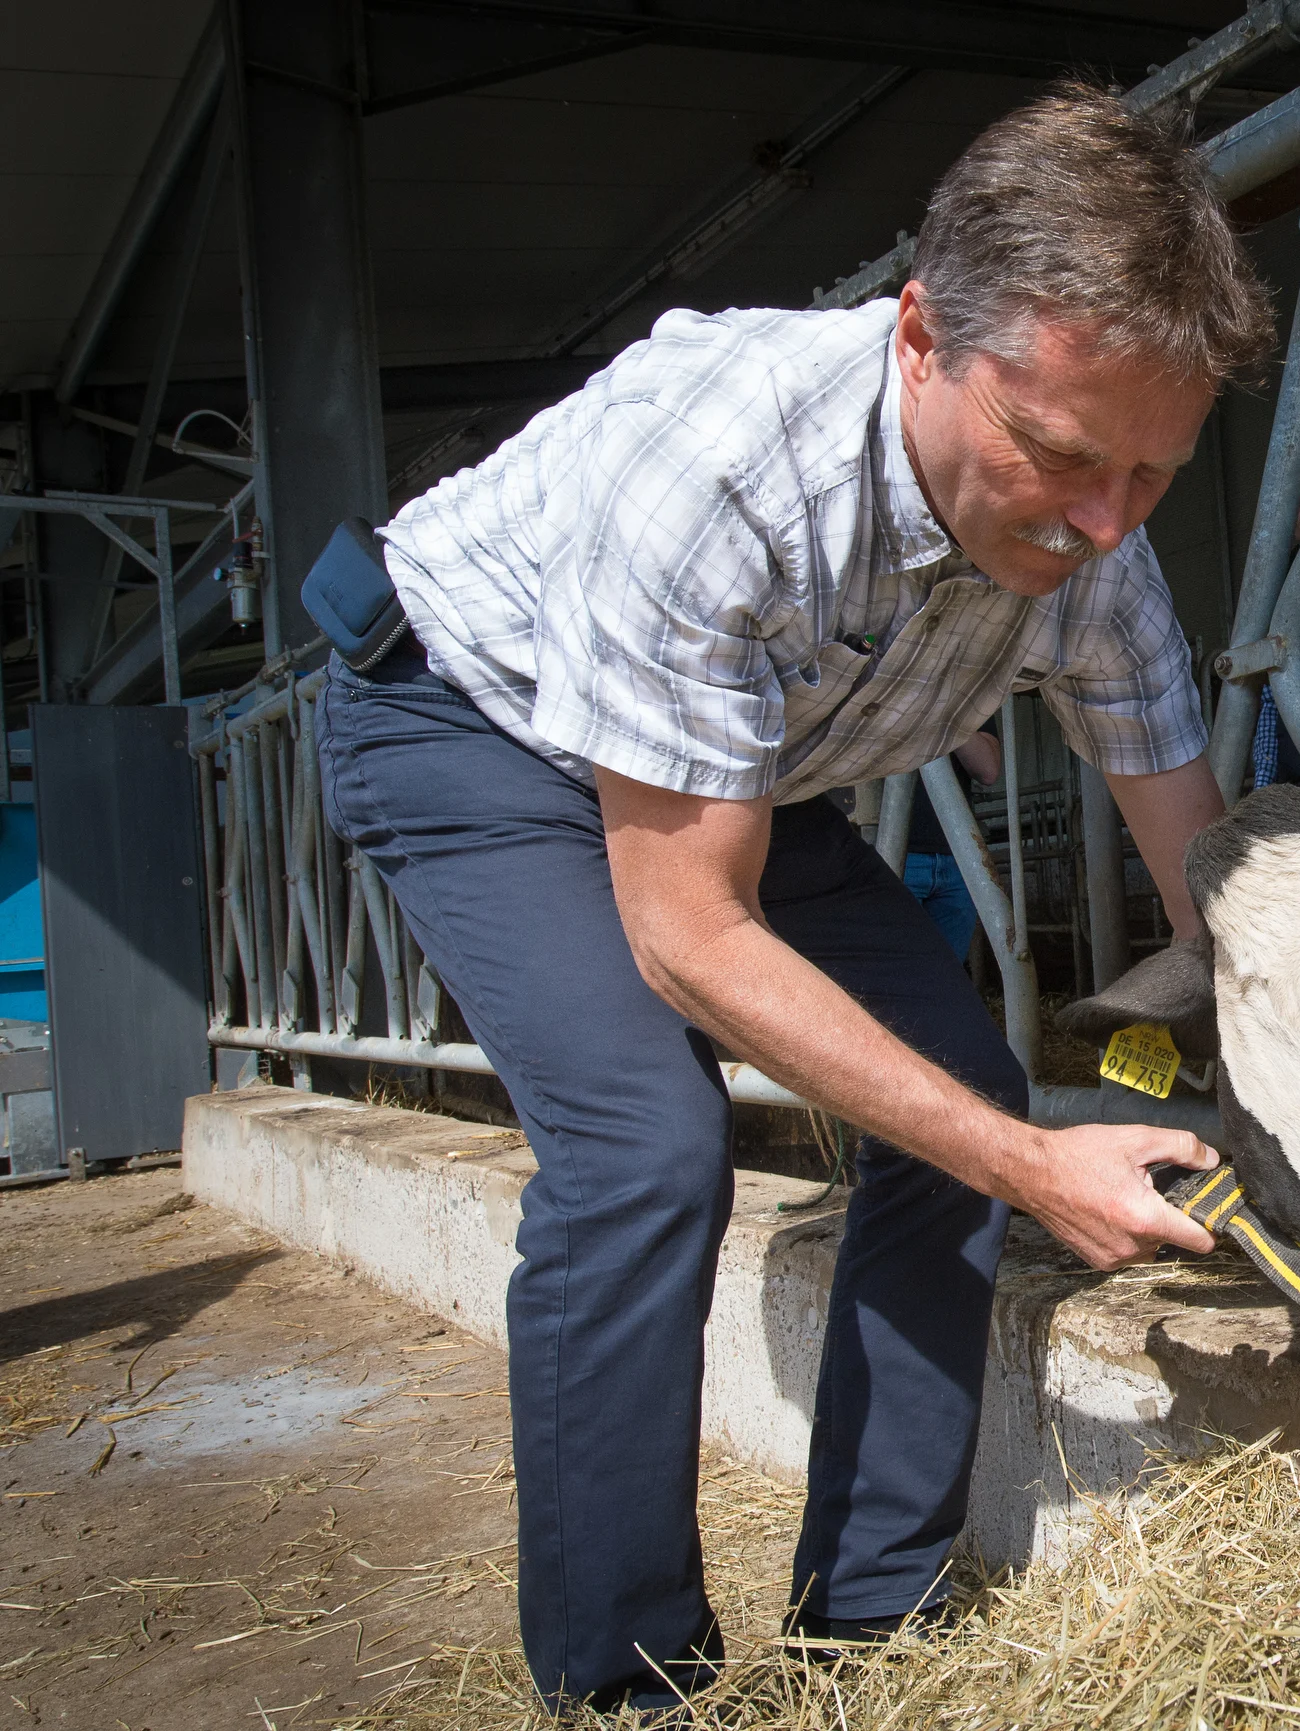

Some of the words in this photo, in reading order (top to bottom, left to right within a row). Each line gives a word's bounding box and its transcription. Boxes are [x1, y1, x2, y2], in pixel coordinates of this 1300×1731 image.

[1118, 1033, 1134, 1046] DE
[1138, 1040, 1151, 1052] 15
[1154, 1047, 1175, 1061] 020
[1104, 1056, 1128, 1081] 94
[1132, 1066, 1168, 1095] 753
